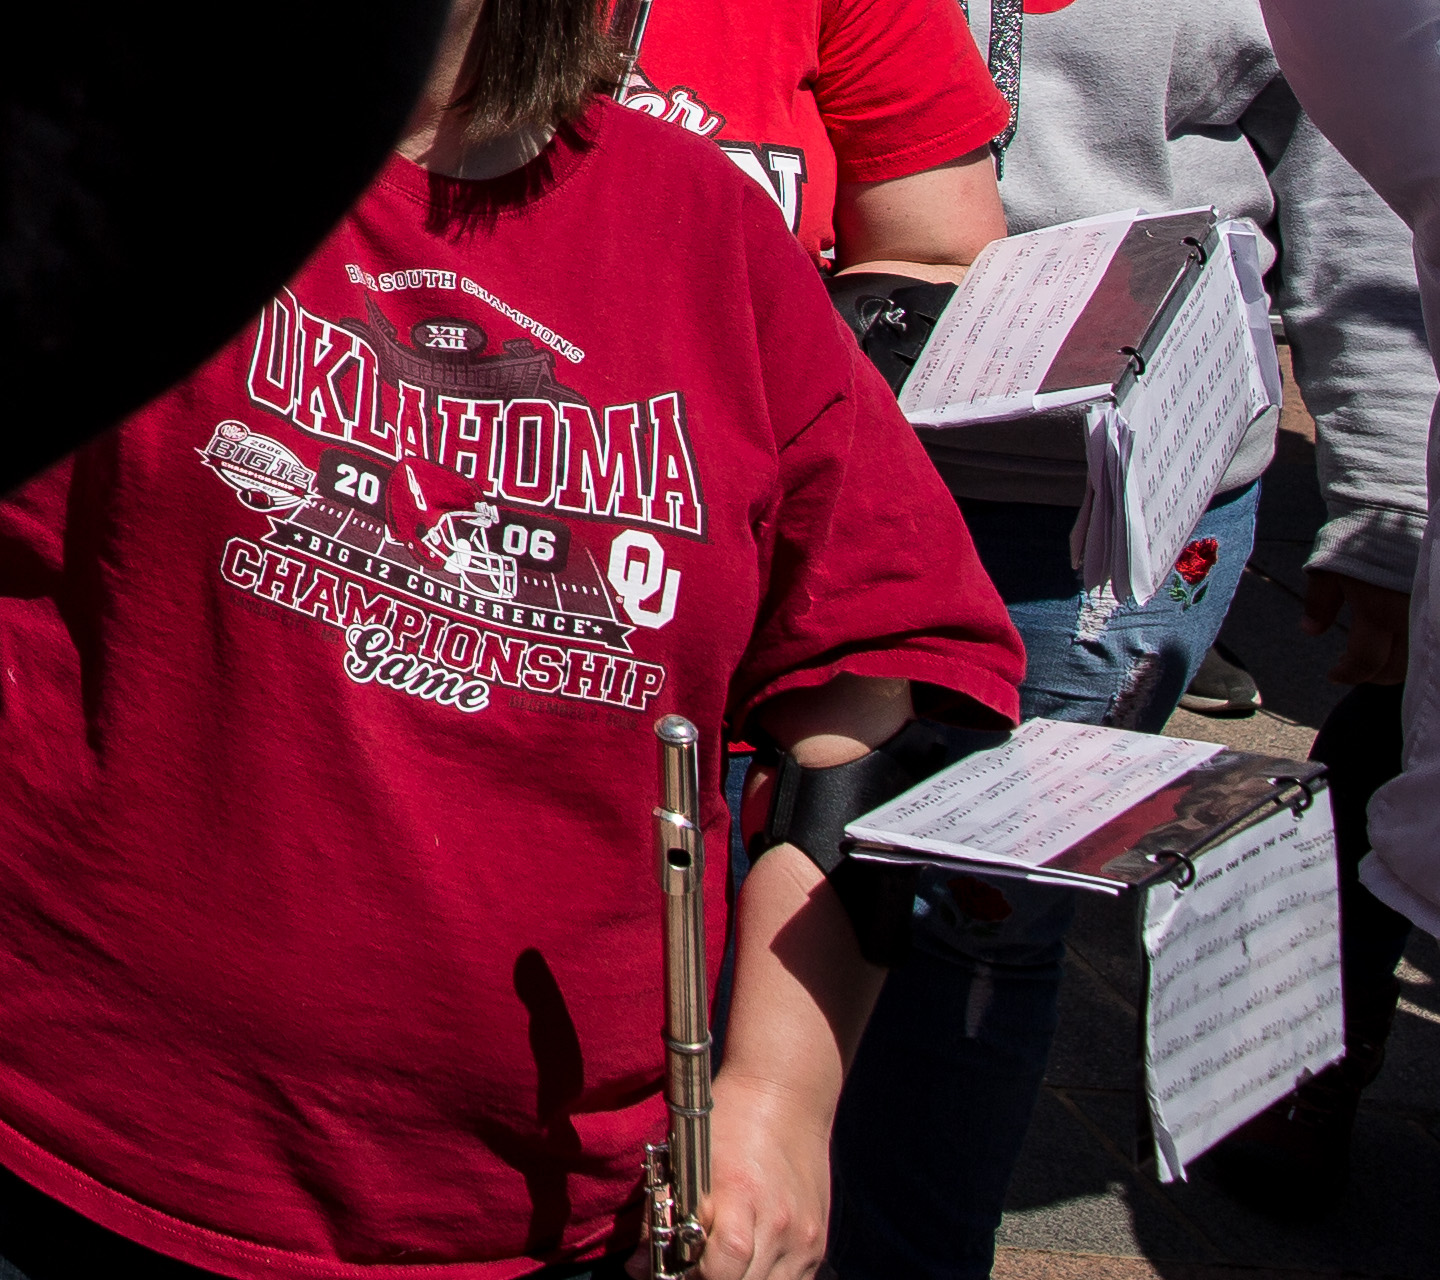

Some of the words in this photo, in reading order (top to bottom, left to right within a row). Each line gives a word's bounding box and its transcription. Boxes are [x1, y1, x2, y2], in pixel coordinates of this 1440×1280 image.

[378, 268, 457, 293] SOUTH
[460, 276, 586, 364] CHAMPIONS
[247, 285, 706, 537] OKLAHOMA
[207, 437, 274, 473] BIG
[272, 458, 312, 490] 12
[220, 460, 296, 491] CHAMPIONSHIP
[334, 462, 380, 504] 20
[308, 534, 350, 564] BIG
[364, 559, 390, 580] 12
[406, 573, 586, 635] CONFERENCE
[502, 525, 556, 563] 06
[607, 528, 681, 630] OU
[220, 536, 666, 712] CHAMPIONSHIP
[345, 624, 491, 713] Game
